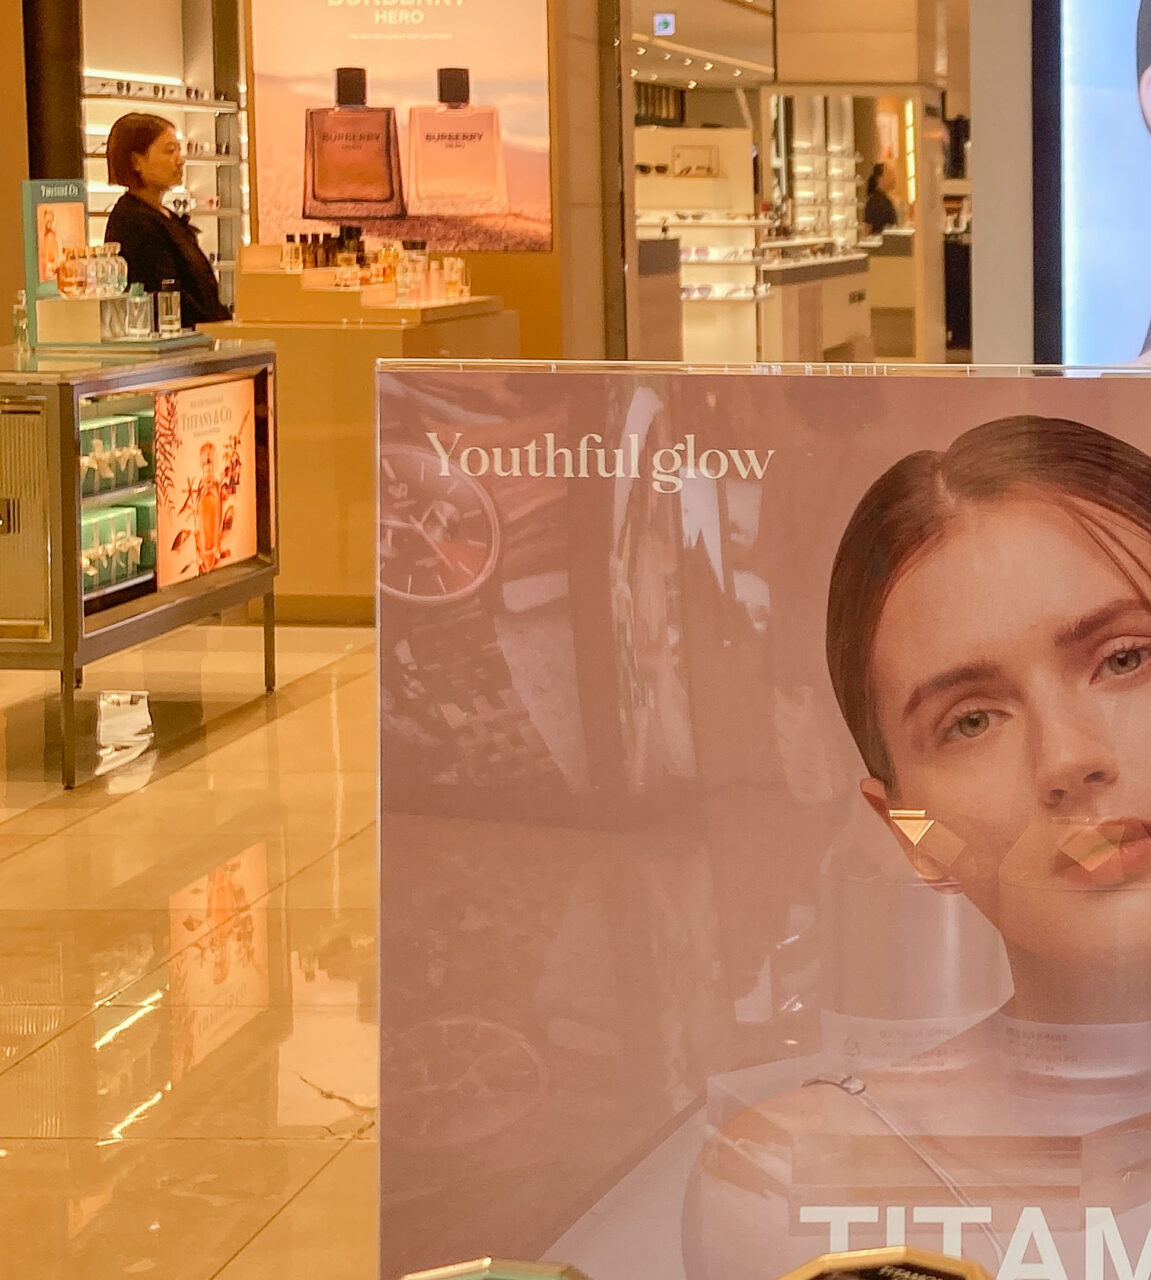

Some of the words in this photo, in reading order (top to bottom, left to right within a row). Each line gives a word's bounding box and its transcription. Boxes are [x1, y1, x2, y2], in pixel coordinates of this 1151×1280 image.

[374, 9, 424, 25] HERO
[425, 432, 640, 478] Youthful
[652, 434, 775, 493] glow
